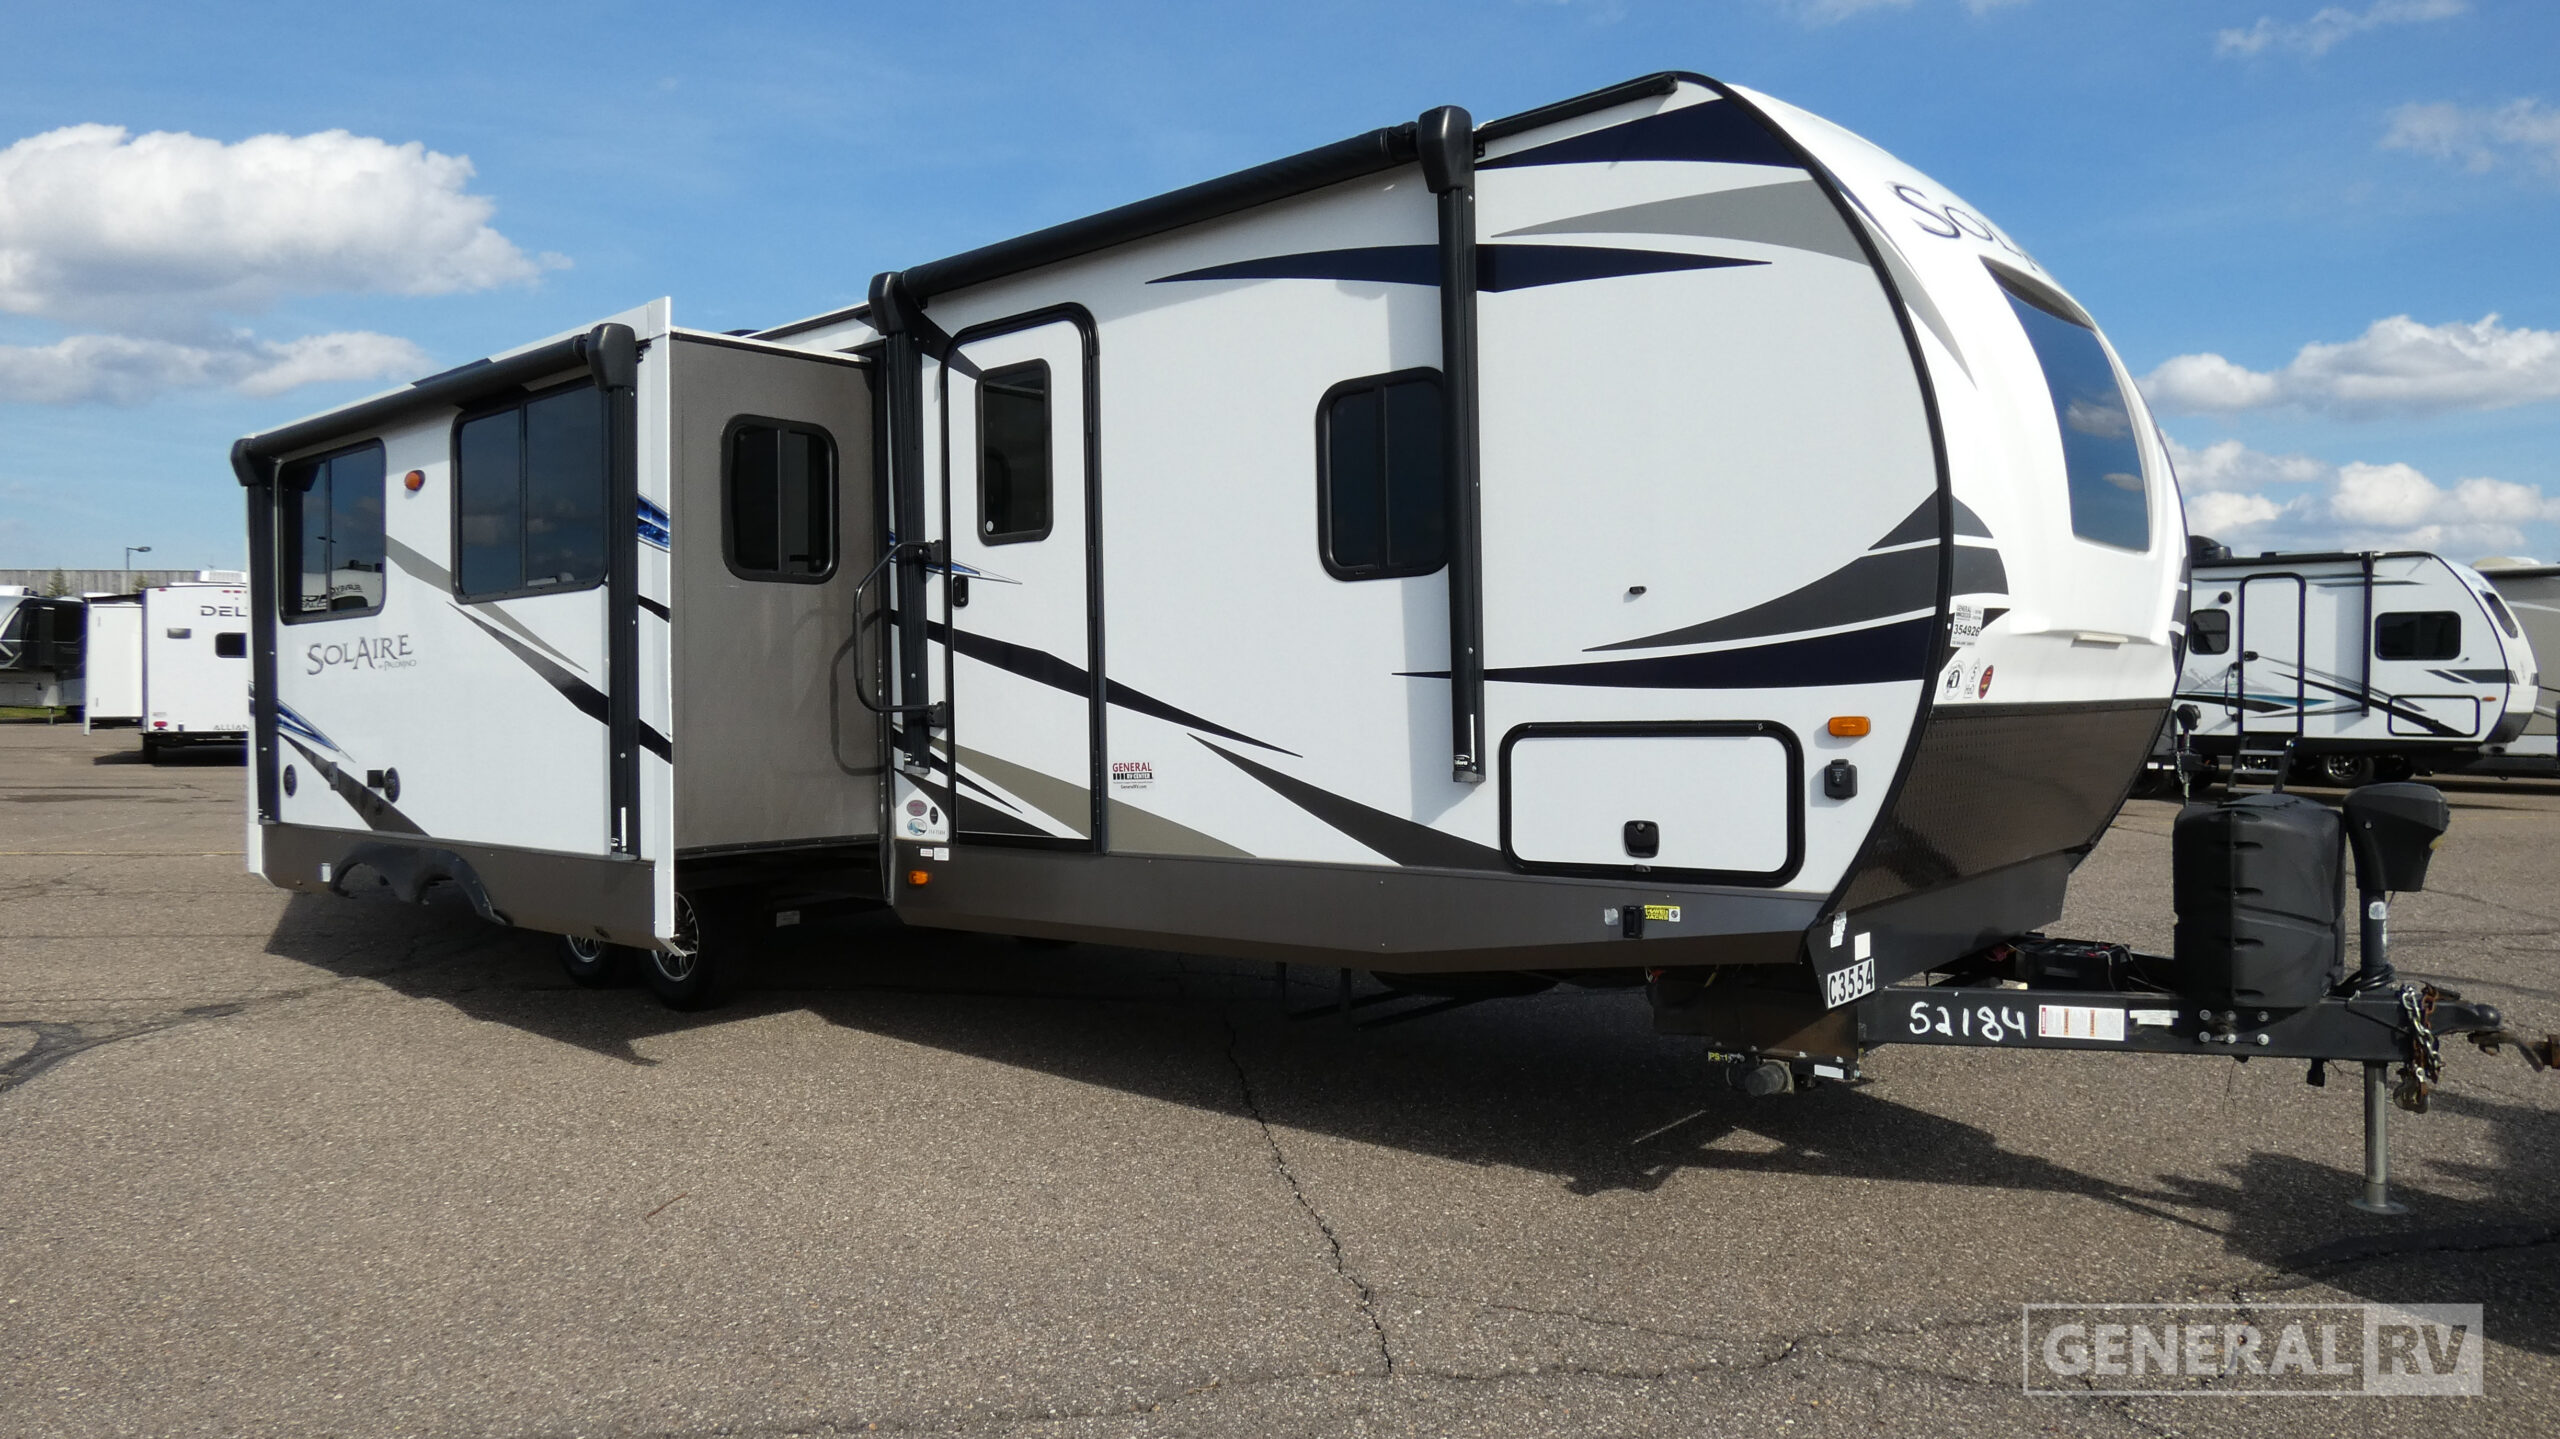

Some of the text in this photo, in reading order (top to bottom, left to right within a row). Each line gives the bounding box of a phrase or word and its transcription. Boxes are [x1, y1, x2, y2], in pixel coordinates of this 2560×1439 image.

[200, 605, 248, 617] DEL
[1953, 624, 1981, 637] 354926
[307, 634, 413, 675] SOLAIRE
[1112, 762, 1152, 772] GENERAL
[1829, 960, 1873, 1005] C3554
[1909, 1001, 2027, 1042] 52184
